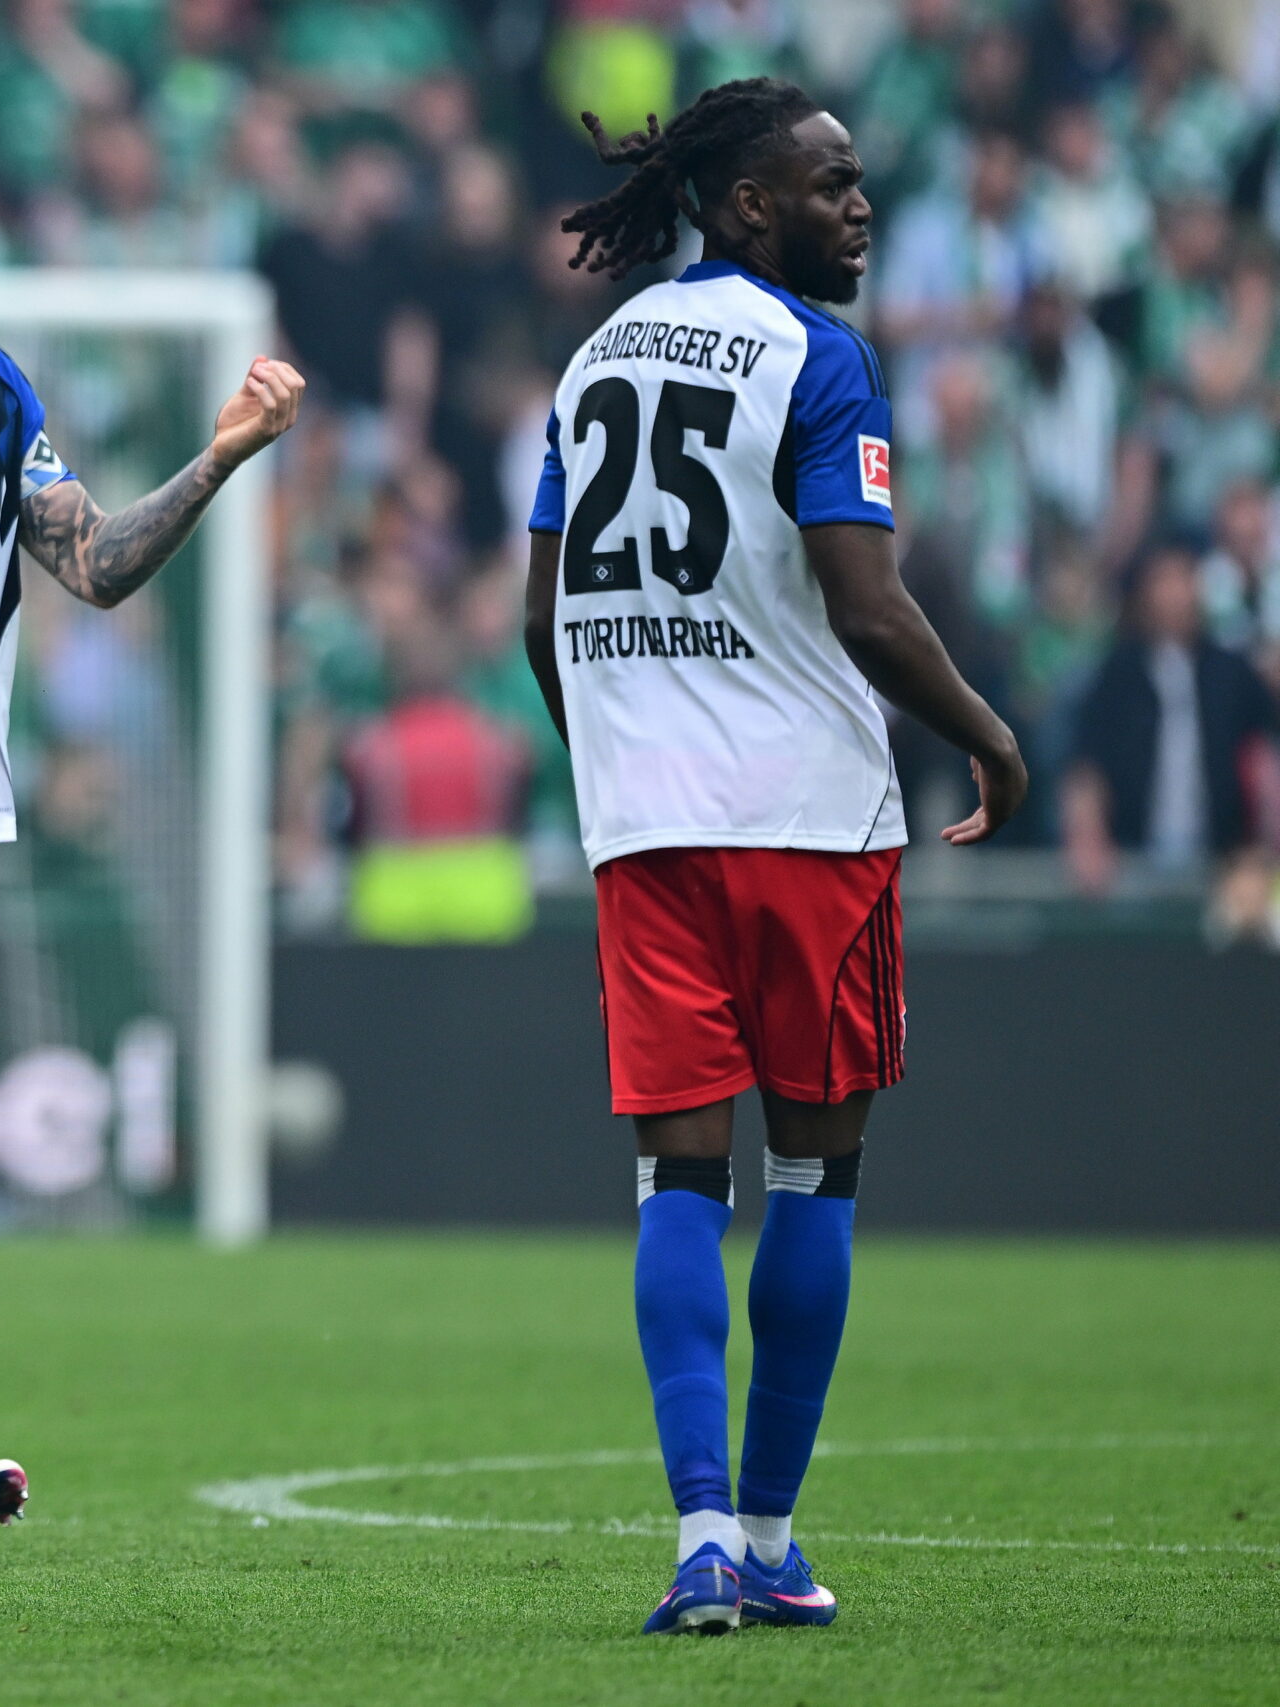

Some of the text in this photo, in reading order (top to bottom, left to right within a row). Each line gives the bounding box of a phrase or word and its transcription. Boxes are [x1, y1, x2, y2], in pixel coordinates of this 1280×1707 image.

[583, 321, 768, 378] HAMBURGER SV
[563, 376, 736, 596] 25
